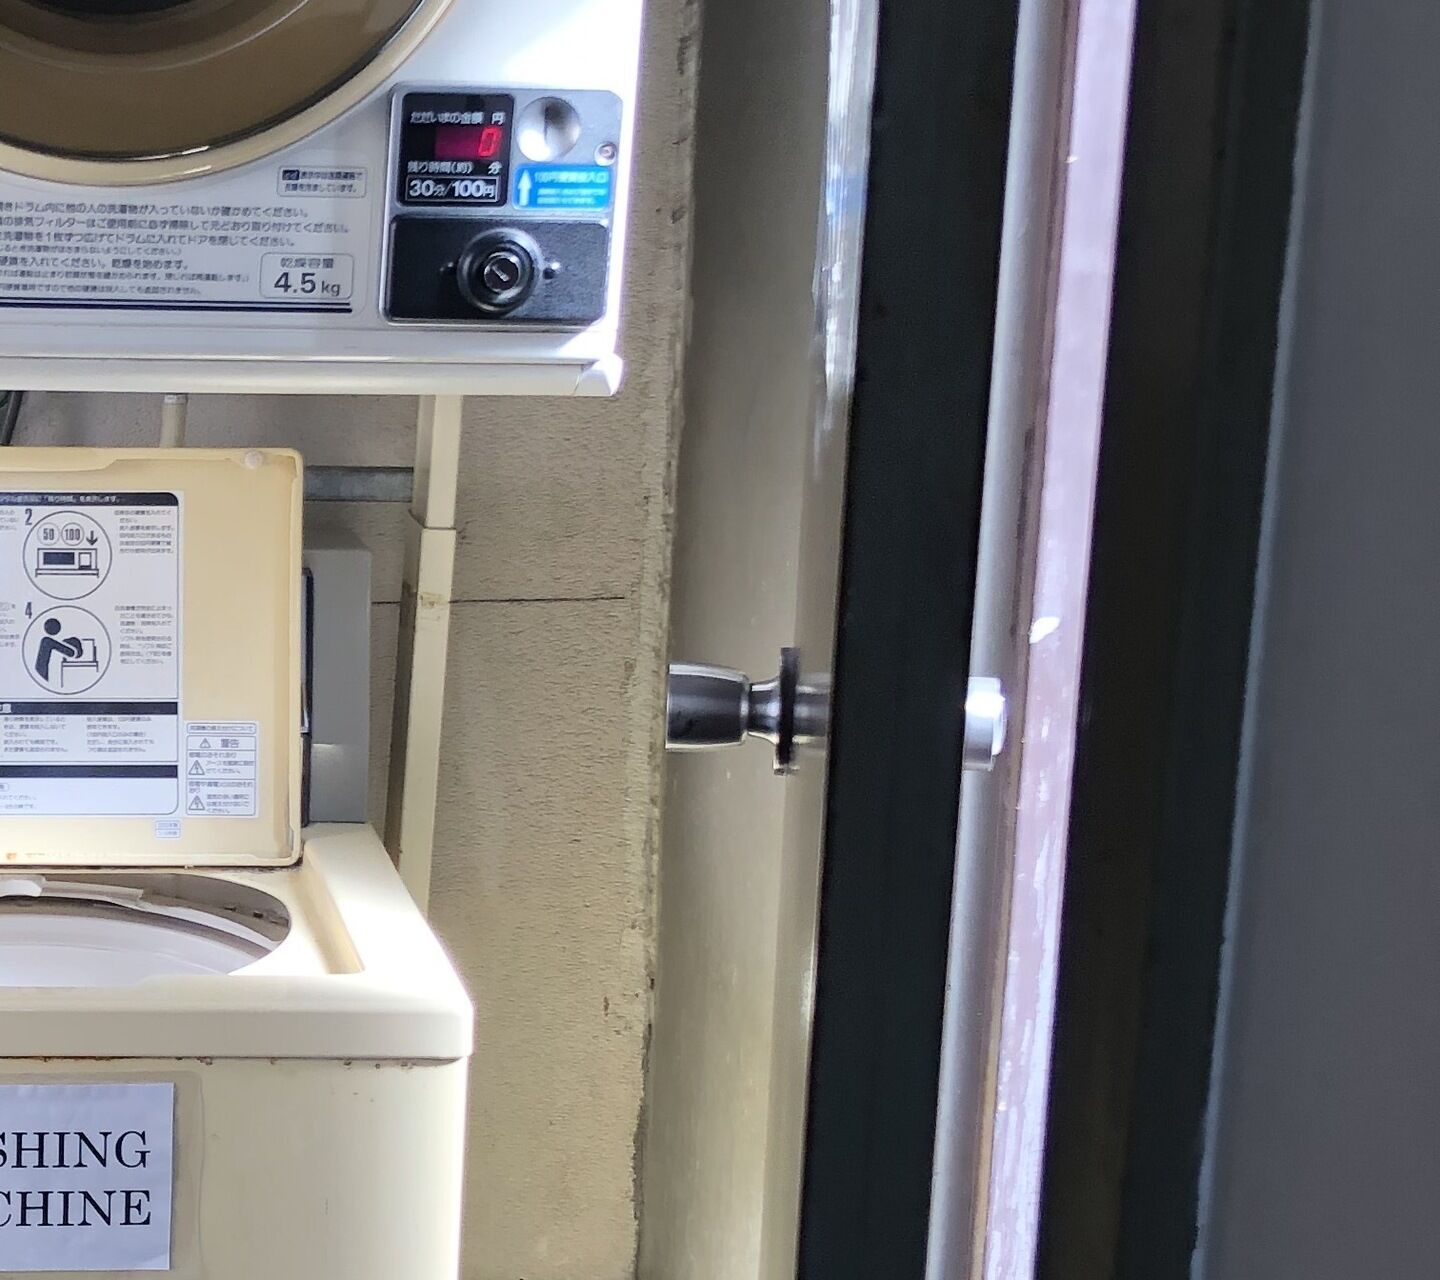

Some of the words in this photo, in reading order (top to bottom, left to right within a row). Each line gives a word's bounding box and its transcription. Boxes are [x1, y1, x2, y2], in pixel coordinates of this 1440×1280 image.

[491, 112, 505, 125] 円
[478, 126, 502, 158] 0
[488, 161, 502, 175] 分
[409, 179, 496, 198] 30分/100円
[280, 257, 334, 269] 乾燥容量
[274, 272, 316, 294] 4.5
[321, 280, 341, 296] kg
[25, 508, 32, 526] 2
[43, 528, 54, 540] 50
[65, 528, 80, 541] 100
[25, 601, 32, 619] 4
